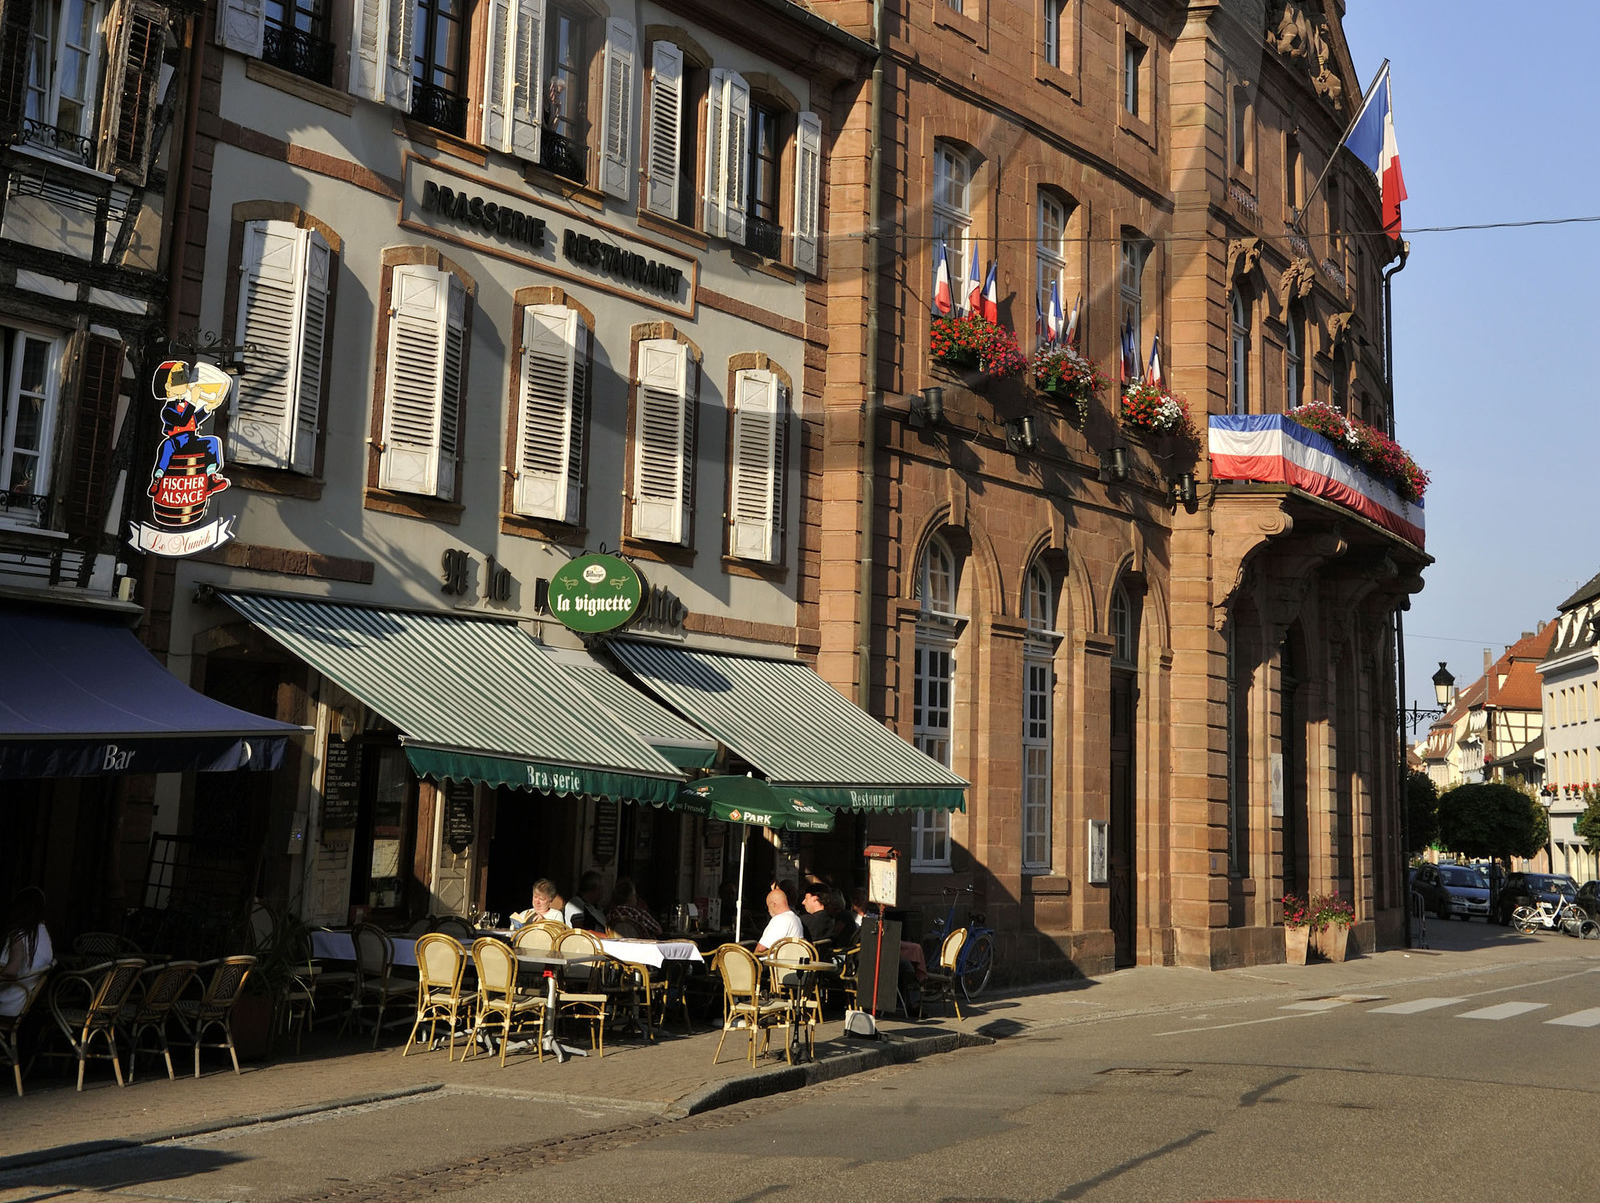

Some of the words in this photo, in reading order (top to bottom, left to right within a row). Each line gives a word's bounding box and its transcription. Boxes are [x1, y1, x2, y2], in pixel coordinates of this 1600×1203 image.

[422, 180, 546, 248] BRASSERIE
[563, 229, 683, 294] RESTAURANT
[162, 476, 205, 490] FISCHER
[161, 490, 204, 504] ALSACE
[146, 531, 165, 553] Le
[557, 594, 571, 612] la
[575, 594, 632, 617] vignette
[102, 744, 136, 771] Bar
[526, 765, 580, 790] Brasserie
[850, 790, 895, 807] Restaurant
[743, 811, 772, 824] PARK
